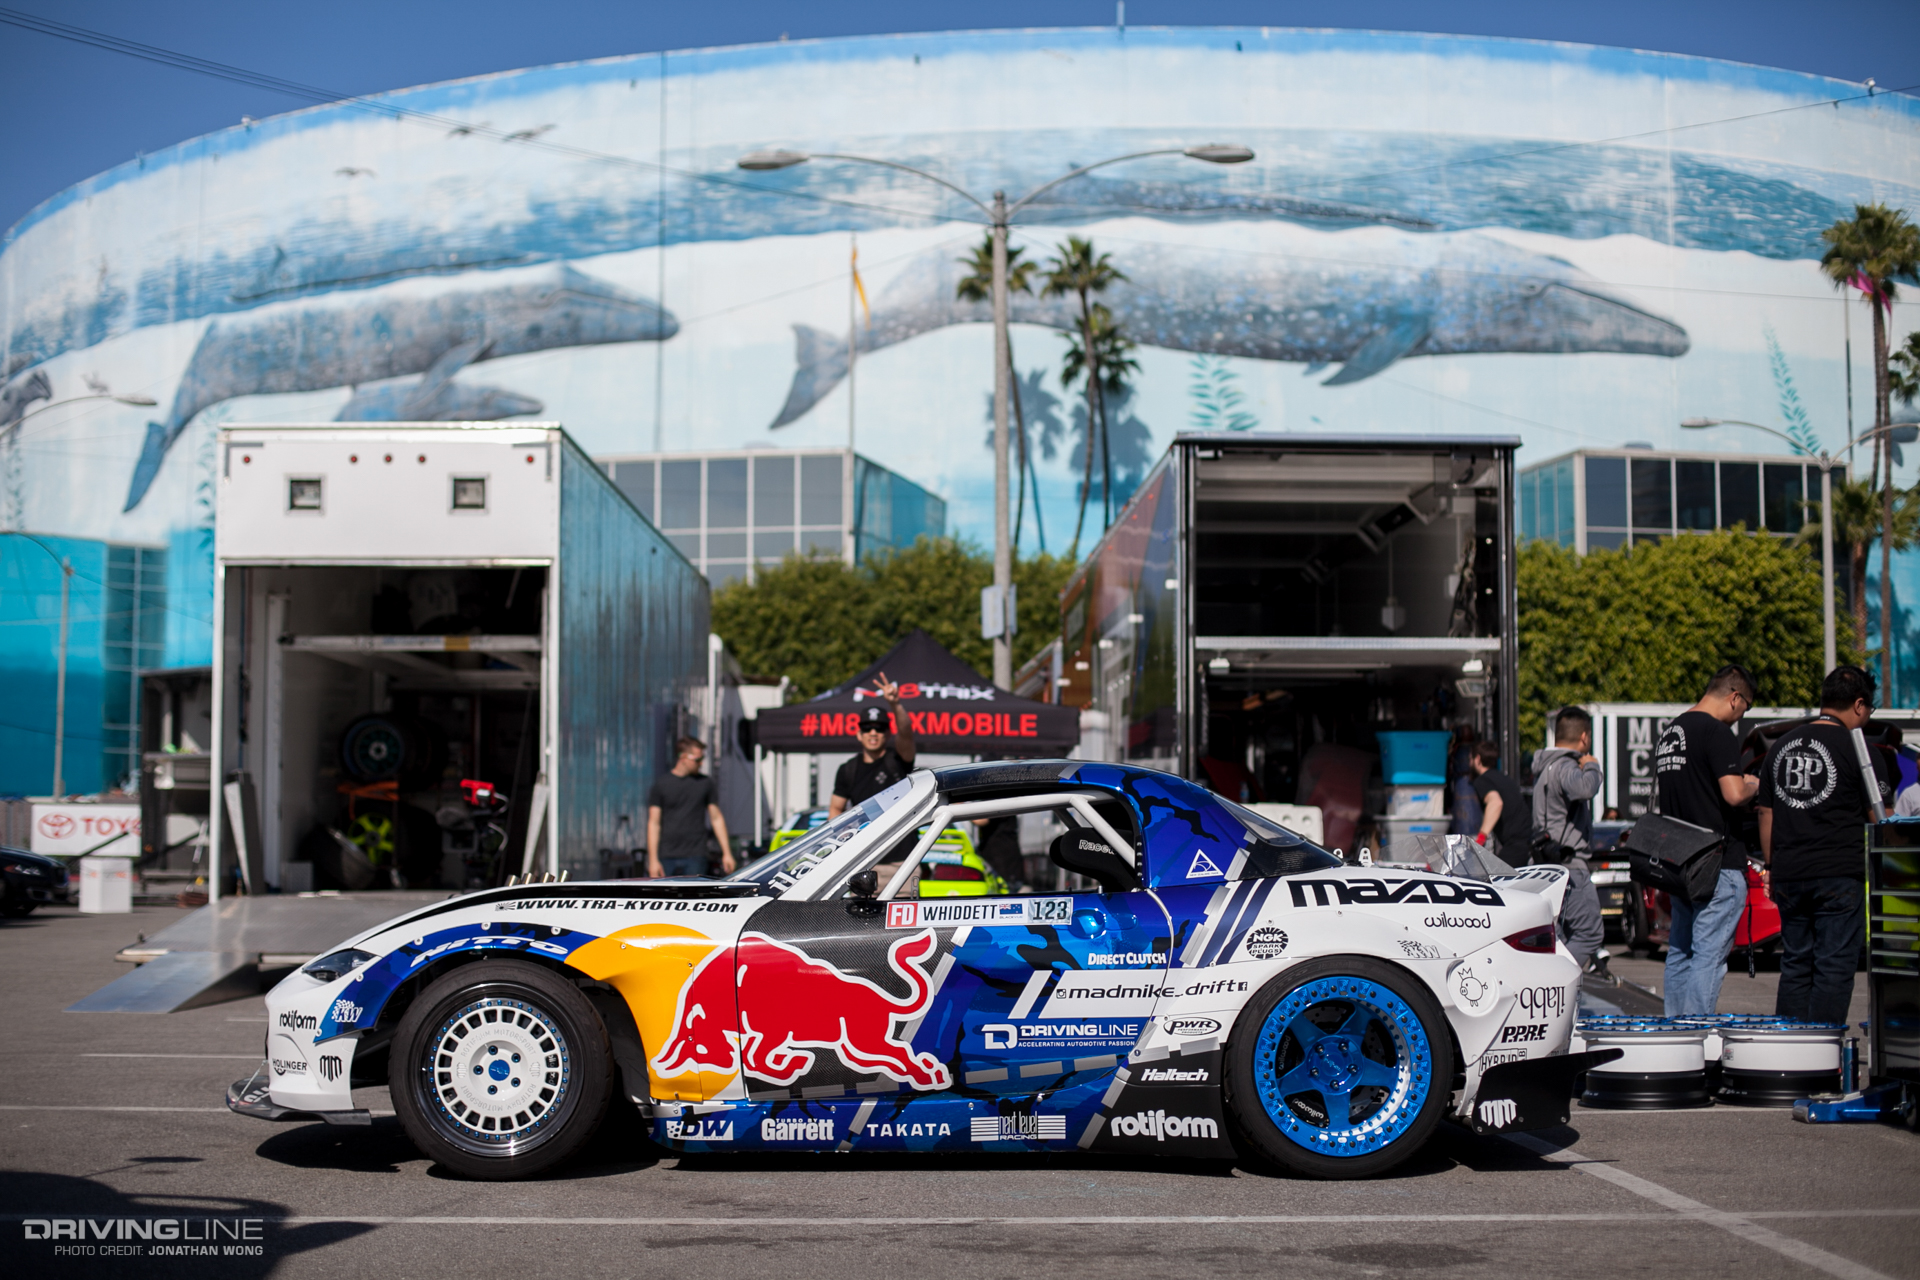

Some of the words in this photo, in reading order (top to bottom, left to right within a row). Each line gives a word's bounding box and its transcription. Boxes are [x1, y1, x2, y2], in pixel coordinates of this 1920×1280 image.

[1784, 756, 1823, 790] BP
[516, 899, 739, 913] WWW.TRA-KYOTO.COM
[890, 904, 915, 926] FD
[923, 904, 998, 922] WHIDDETT
[1033, 901, 1067, 921] 123
[1424, 912, 1492, 929] wilwood
[1253, 933, 1283, 942] NGK
[410, 935, 569, 968] NITTO
[1088, 952, 1126, 966] DIRECT
[1126, 951, 1167, 965] CLUTCH
[1520, 986, 1566, 1019] ilabb
[280, 1010, 317, 1031] rotiform
[1169, 1020, 1212, 1035] PWR
[1020, 1024, 1139, 1037] DRIVINGLINE
[272, 1058, 307, 1071] HOLINGER
[1141, 1068, 1209, 1082] Haltech
[761, 1118, 835, 1141] Garrett
[866, 1123, 951, 1137] TAKATA
[998, 1111, 1017, 1134] next
[1019, 1110, 1038, 1134] level
[1110, 1109, 1219, 1142] rotiform
